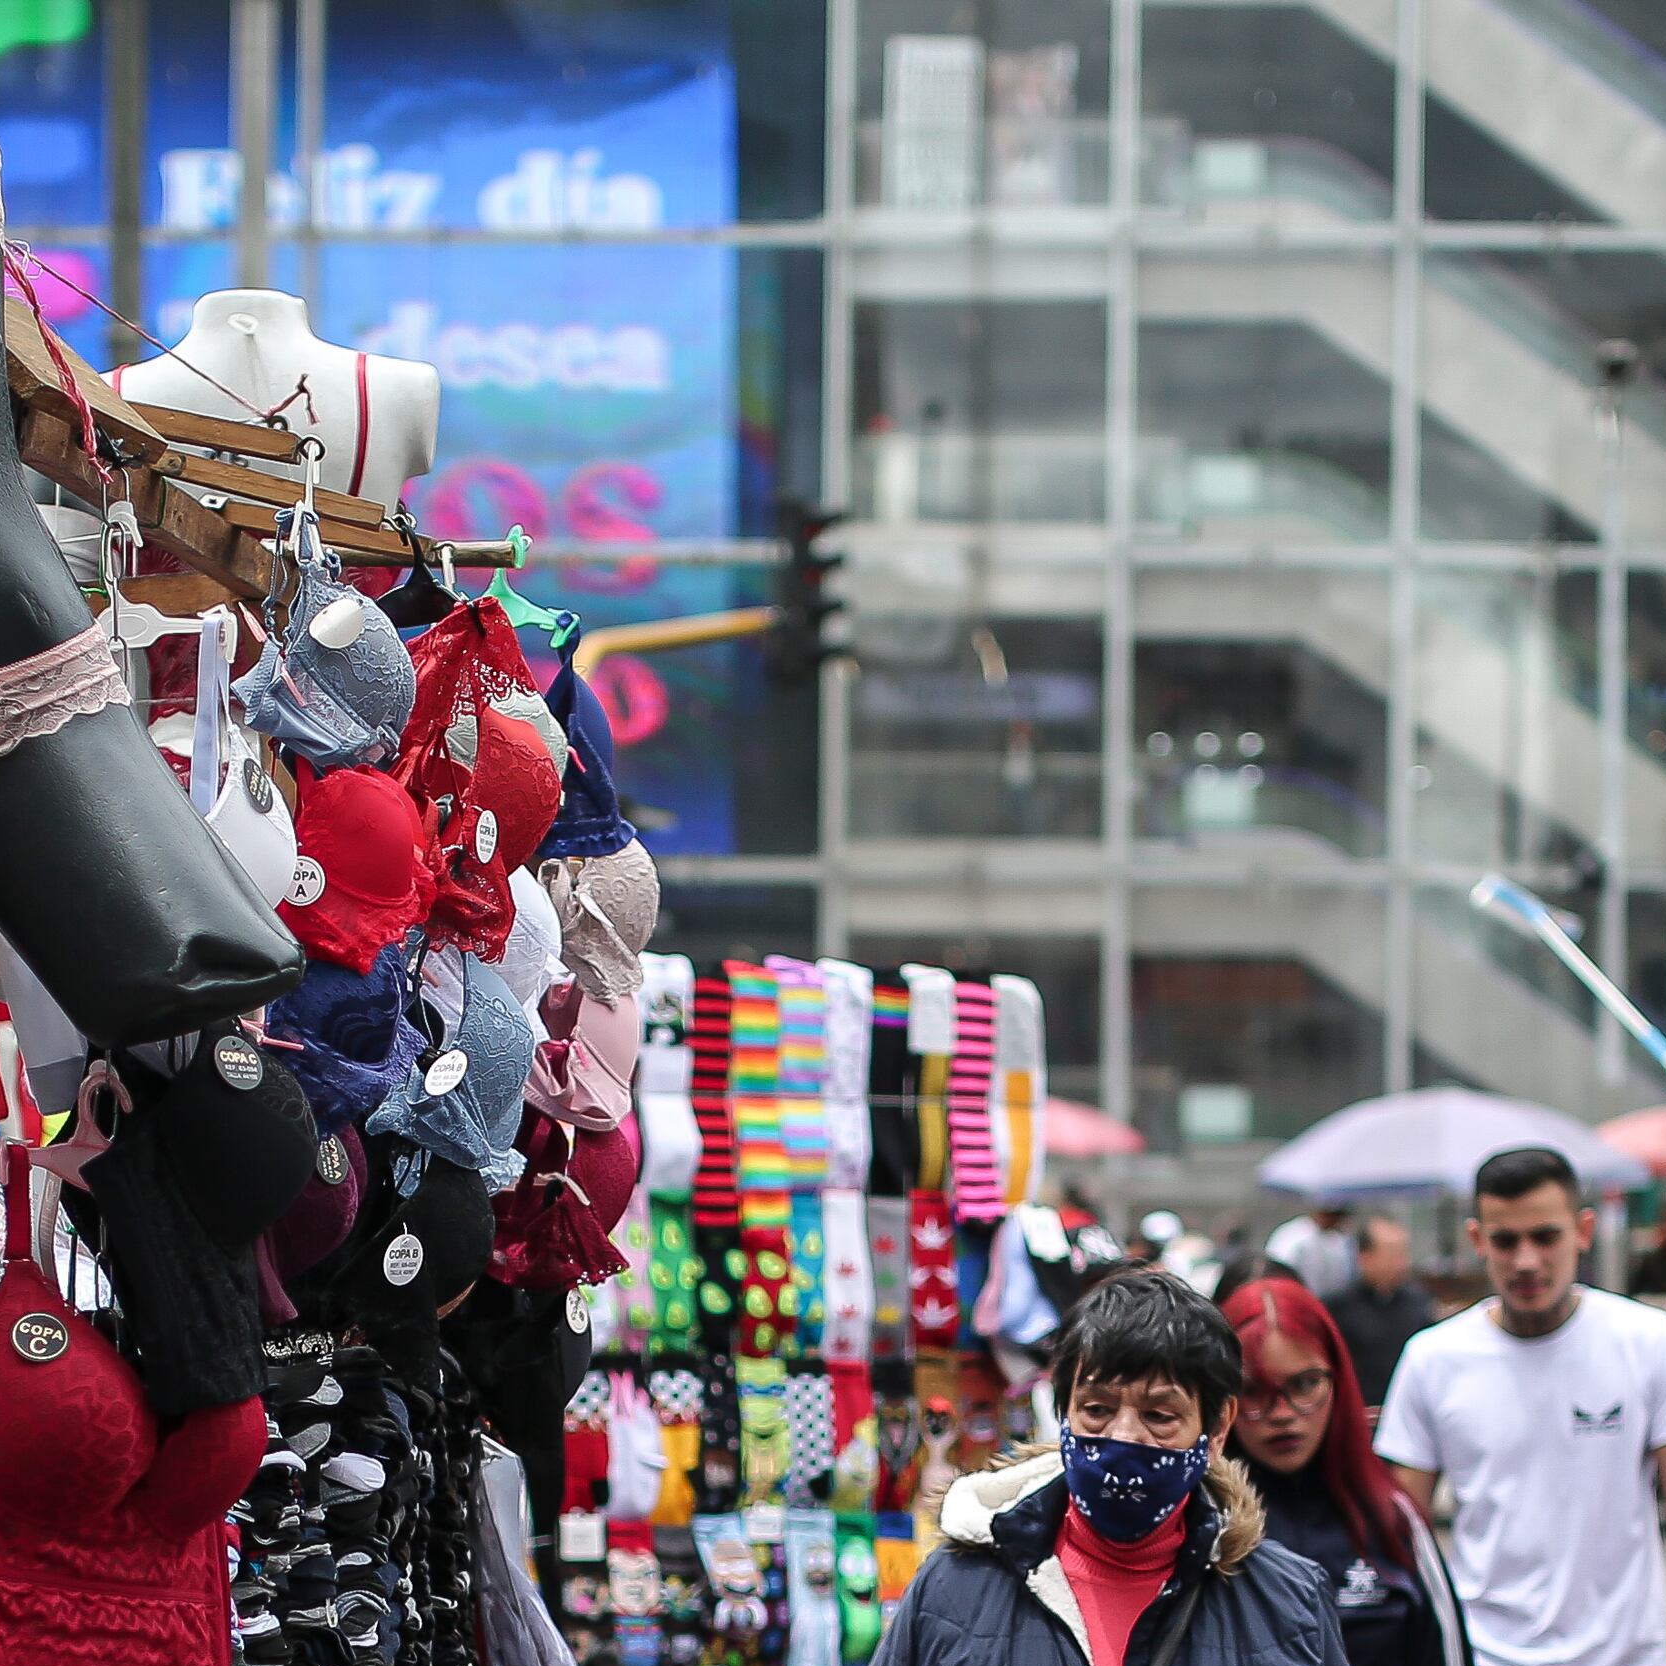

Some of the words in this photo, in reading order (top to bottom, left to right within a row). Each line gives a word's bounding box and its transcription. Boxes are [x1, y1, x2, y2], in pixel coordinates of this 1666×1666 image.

[293, 871, 318, 882] OPA
[295, 885, 308, 898] A
[219, 1050, 249, 1064] COPA
[248, 1053, 258, 1065] C
[433, 1063, 455, 1073] COPA
[328, 1137, 341, 1169] COPA
[333, 1170, 342, 1180] A
[389, 1248, 411, 1260] COPA
[411, 1248, 419, 1259] B
[18, 1321, 64, 1342] COPA
[29, 1336, 48, 1354] C
